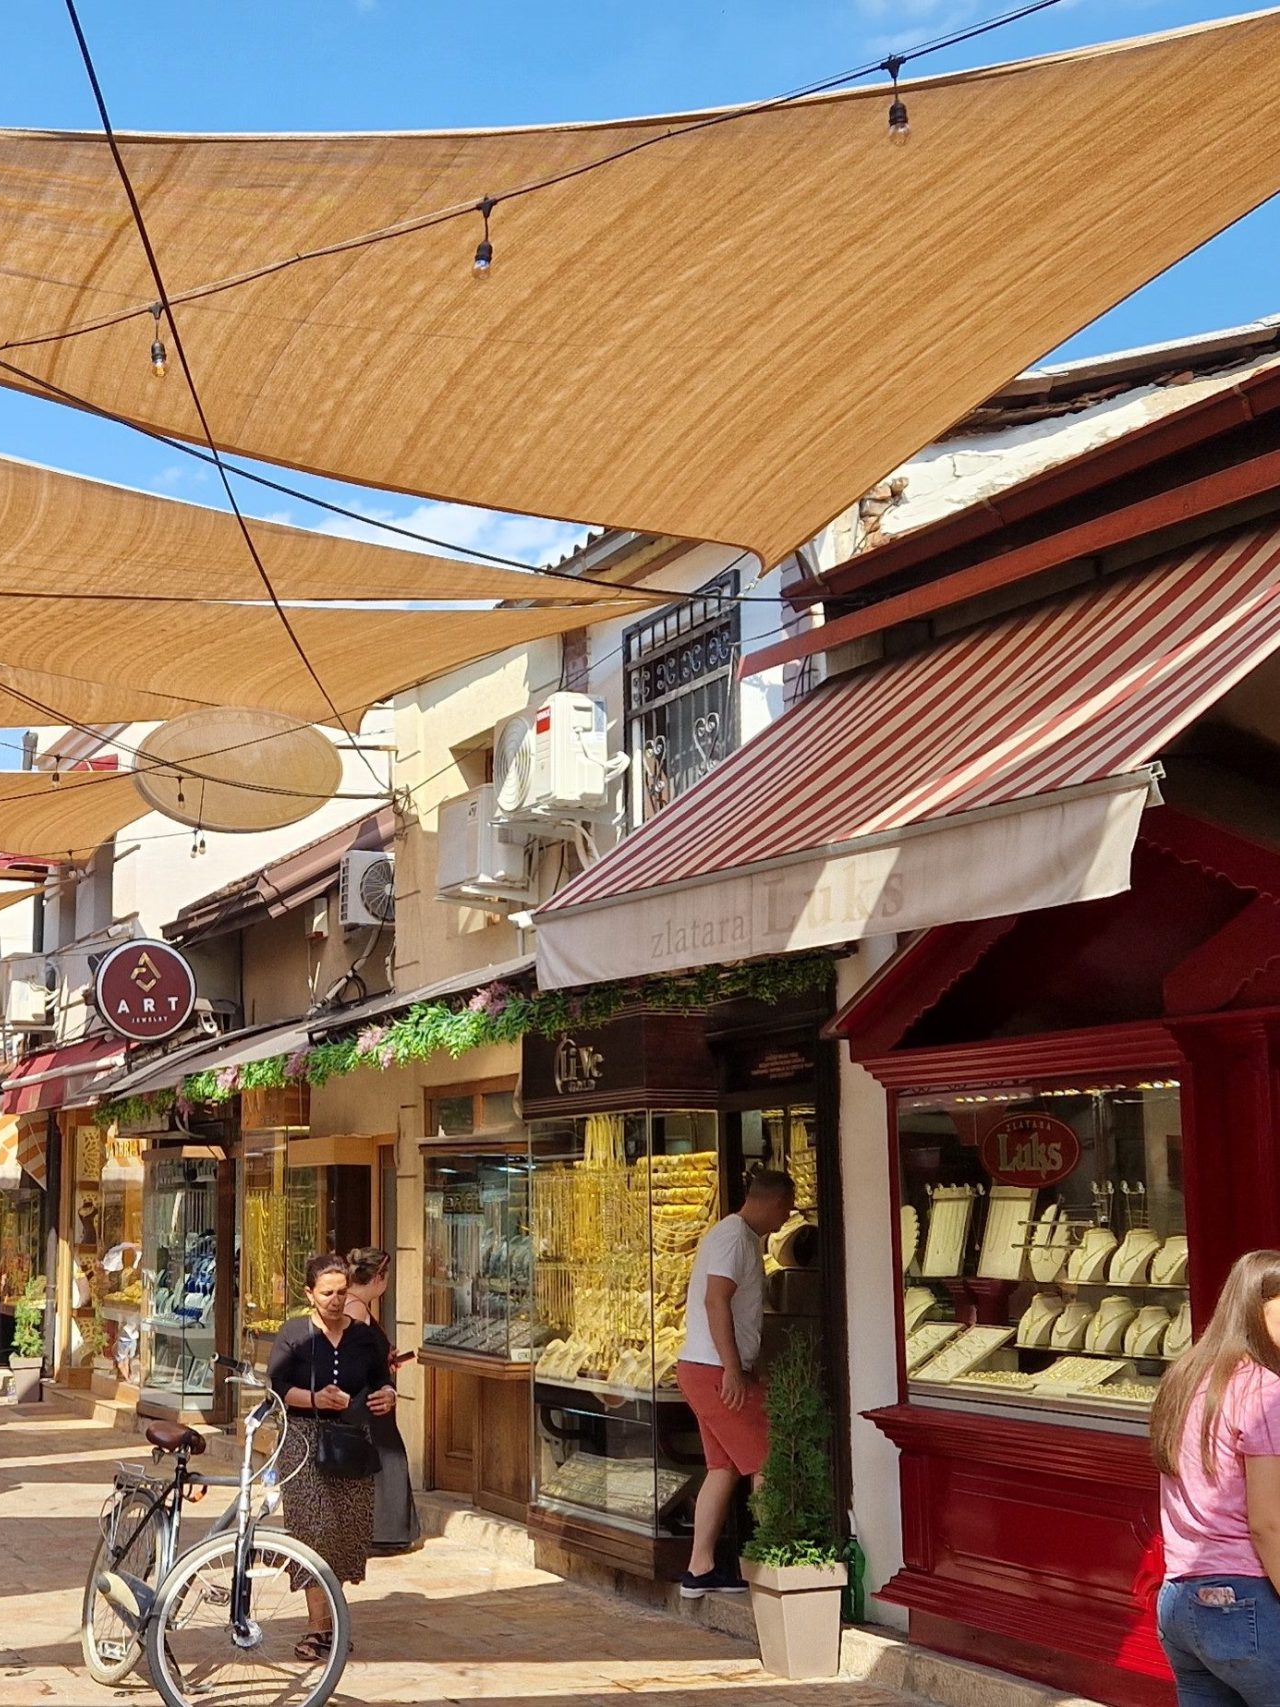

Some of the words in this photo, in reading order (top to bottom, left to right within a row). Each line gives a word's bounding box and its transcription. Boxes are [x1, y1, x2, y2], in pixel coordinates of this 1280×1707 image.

[650, 915, 745, 959] zlatara
[763, 860, 904, 937] Luks
[117, 997, 179, 1014] ART
[1006, 1120, 1051, 1132] ZLATARA
[997, 1131, 1063, 1179] Luks
